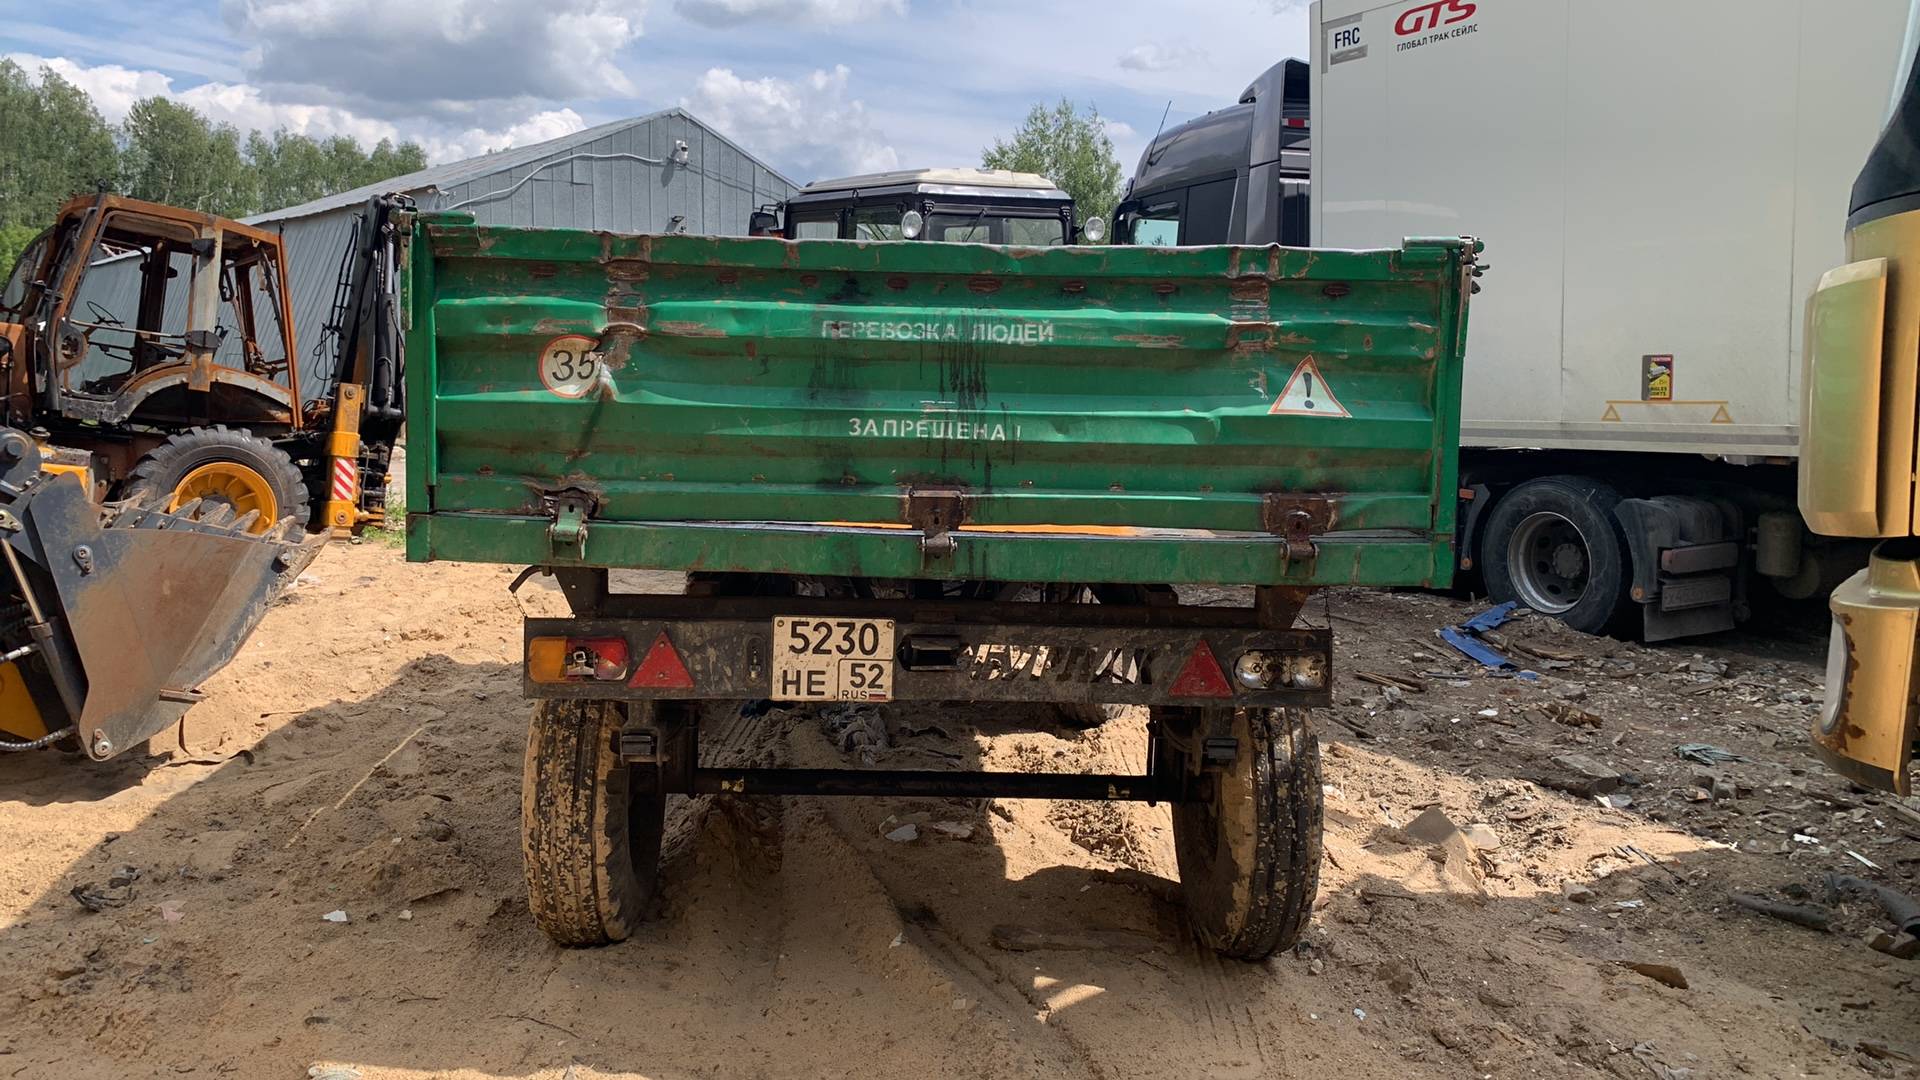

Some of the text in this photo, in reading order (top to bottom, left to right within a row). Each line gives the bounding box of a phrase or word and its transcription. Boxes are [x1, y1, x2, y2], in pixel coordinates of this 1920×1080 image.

[1395, 0, 1476, 35] GTS
[1334, 27, 1361, 49] FRC
[1396, 23, 1479, 52] ГЛОБАЛ ТРАК СЕЙЛС
[821, 319, 1055, 345] ПЕРЕВОЗКА ЛЮДЕЙ
[552, 350, 604, 381] 35
[848, 417, 1006, 441] ЗАПРЕЩЕНА
[789, 620, 880, 656] 5230
[850, 662, 885, 690] 52
[841, 689, 868, 700] RUS
